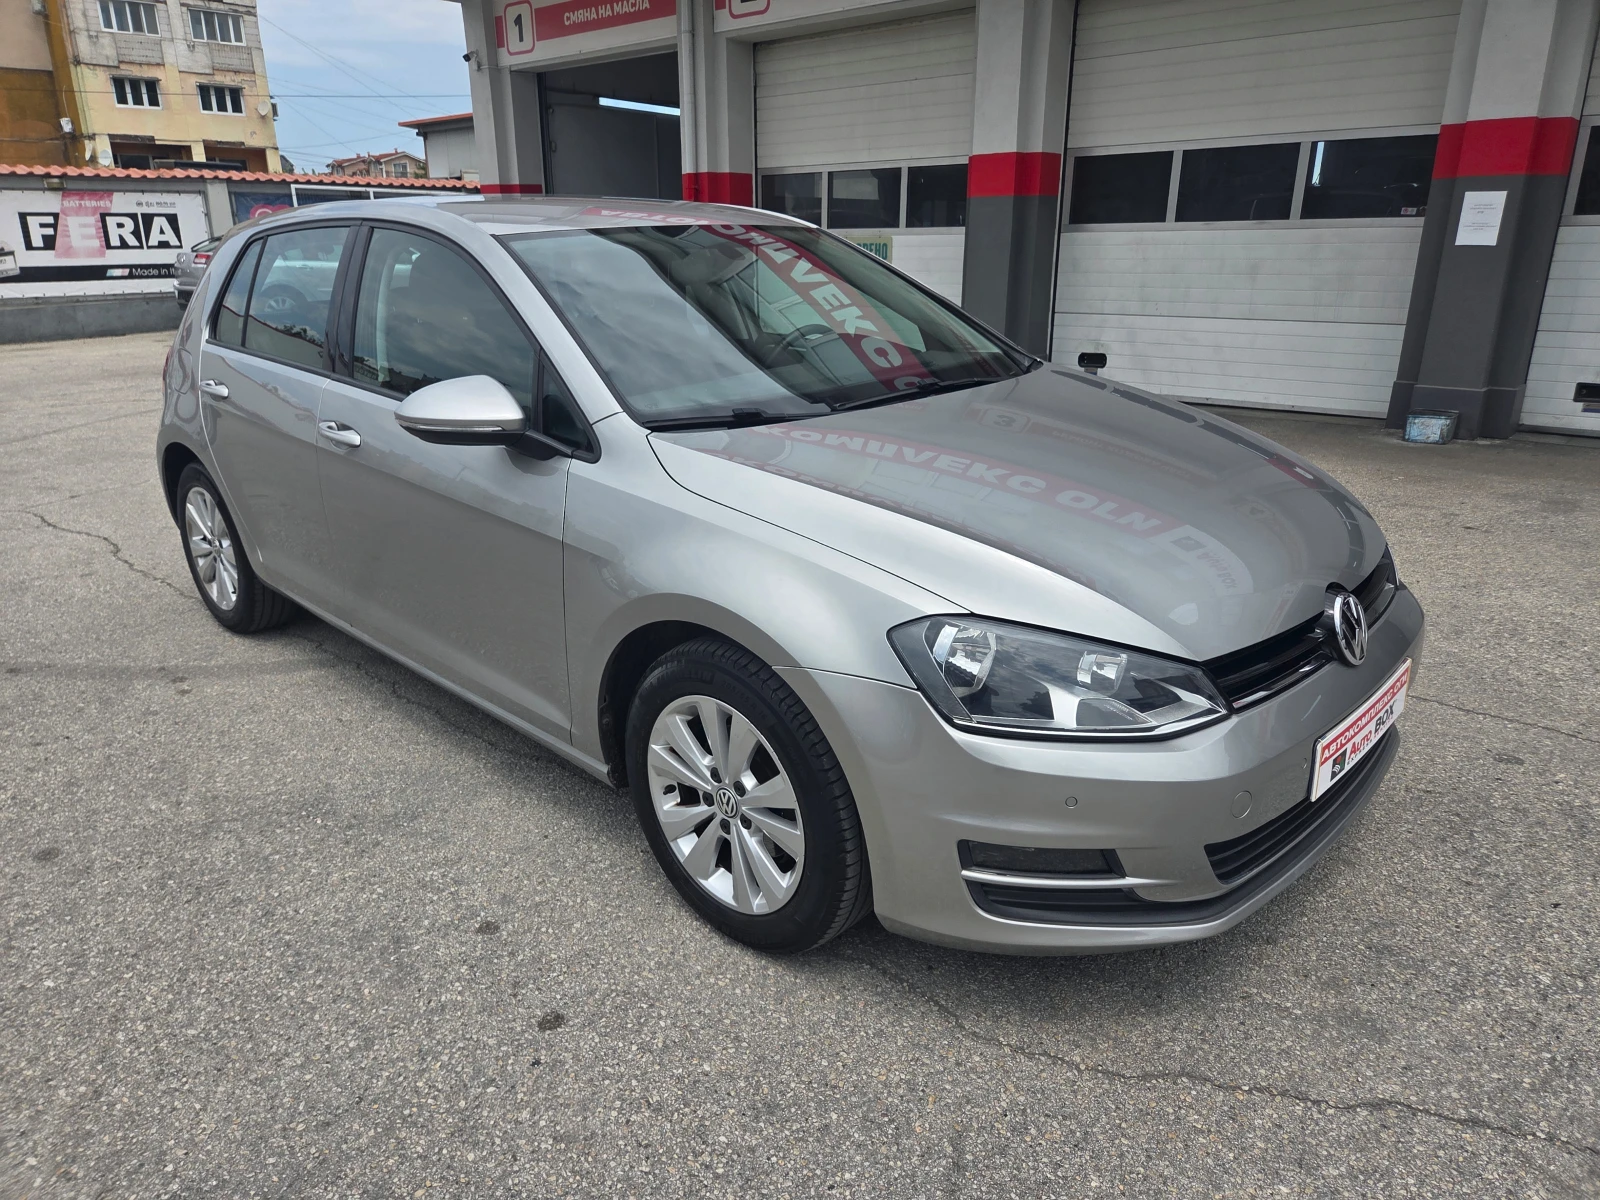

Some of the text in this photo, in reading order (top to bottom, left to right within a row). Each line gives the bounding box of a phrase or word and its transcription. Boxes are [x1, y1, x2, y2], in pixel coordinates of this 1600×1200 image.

[514, 13, 524, 43] 1
[564, 0, 650, 26] СМЯНА НА МАСЛА
[63, 200, 111, 208] BATTERIES
[26, 214, 181, 248] FERA
[132, 267, 159, 276] Made
[160, 267, 169, 275] in
[1321, 688, 1393, 762] АВТОКОМПЛЕКС
[1374, 699, 1397, 734] BOX
